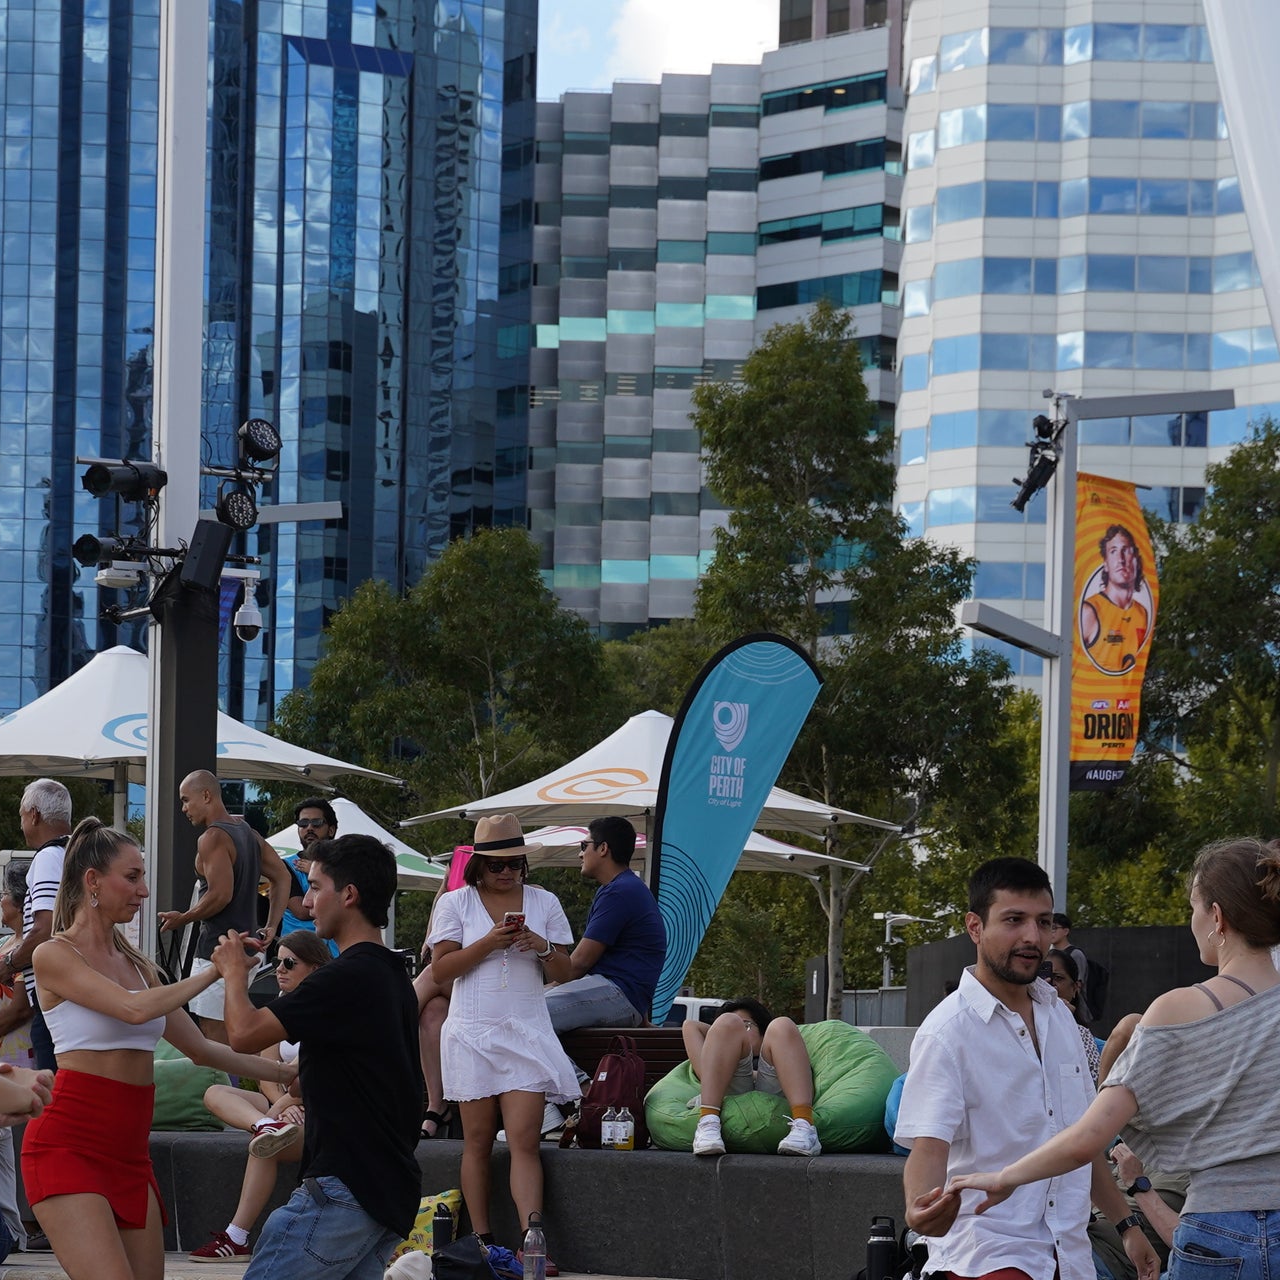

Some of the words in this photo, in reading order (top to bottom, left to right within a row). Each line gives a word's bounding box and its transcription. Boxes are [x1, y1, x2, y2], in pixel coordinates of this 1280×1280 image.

[710, 755, 733, 775] CITY
[734, 757, 747, 776] OF
[709, 775, 744, 799] PERTH
